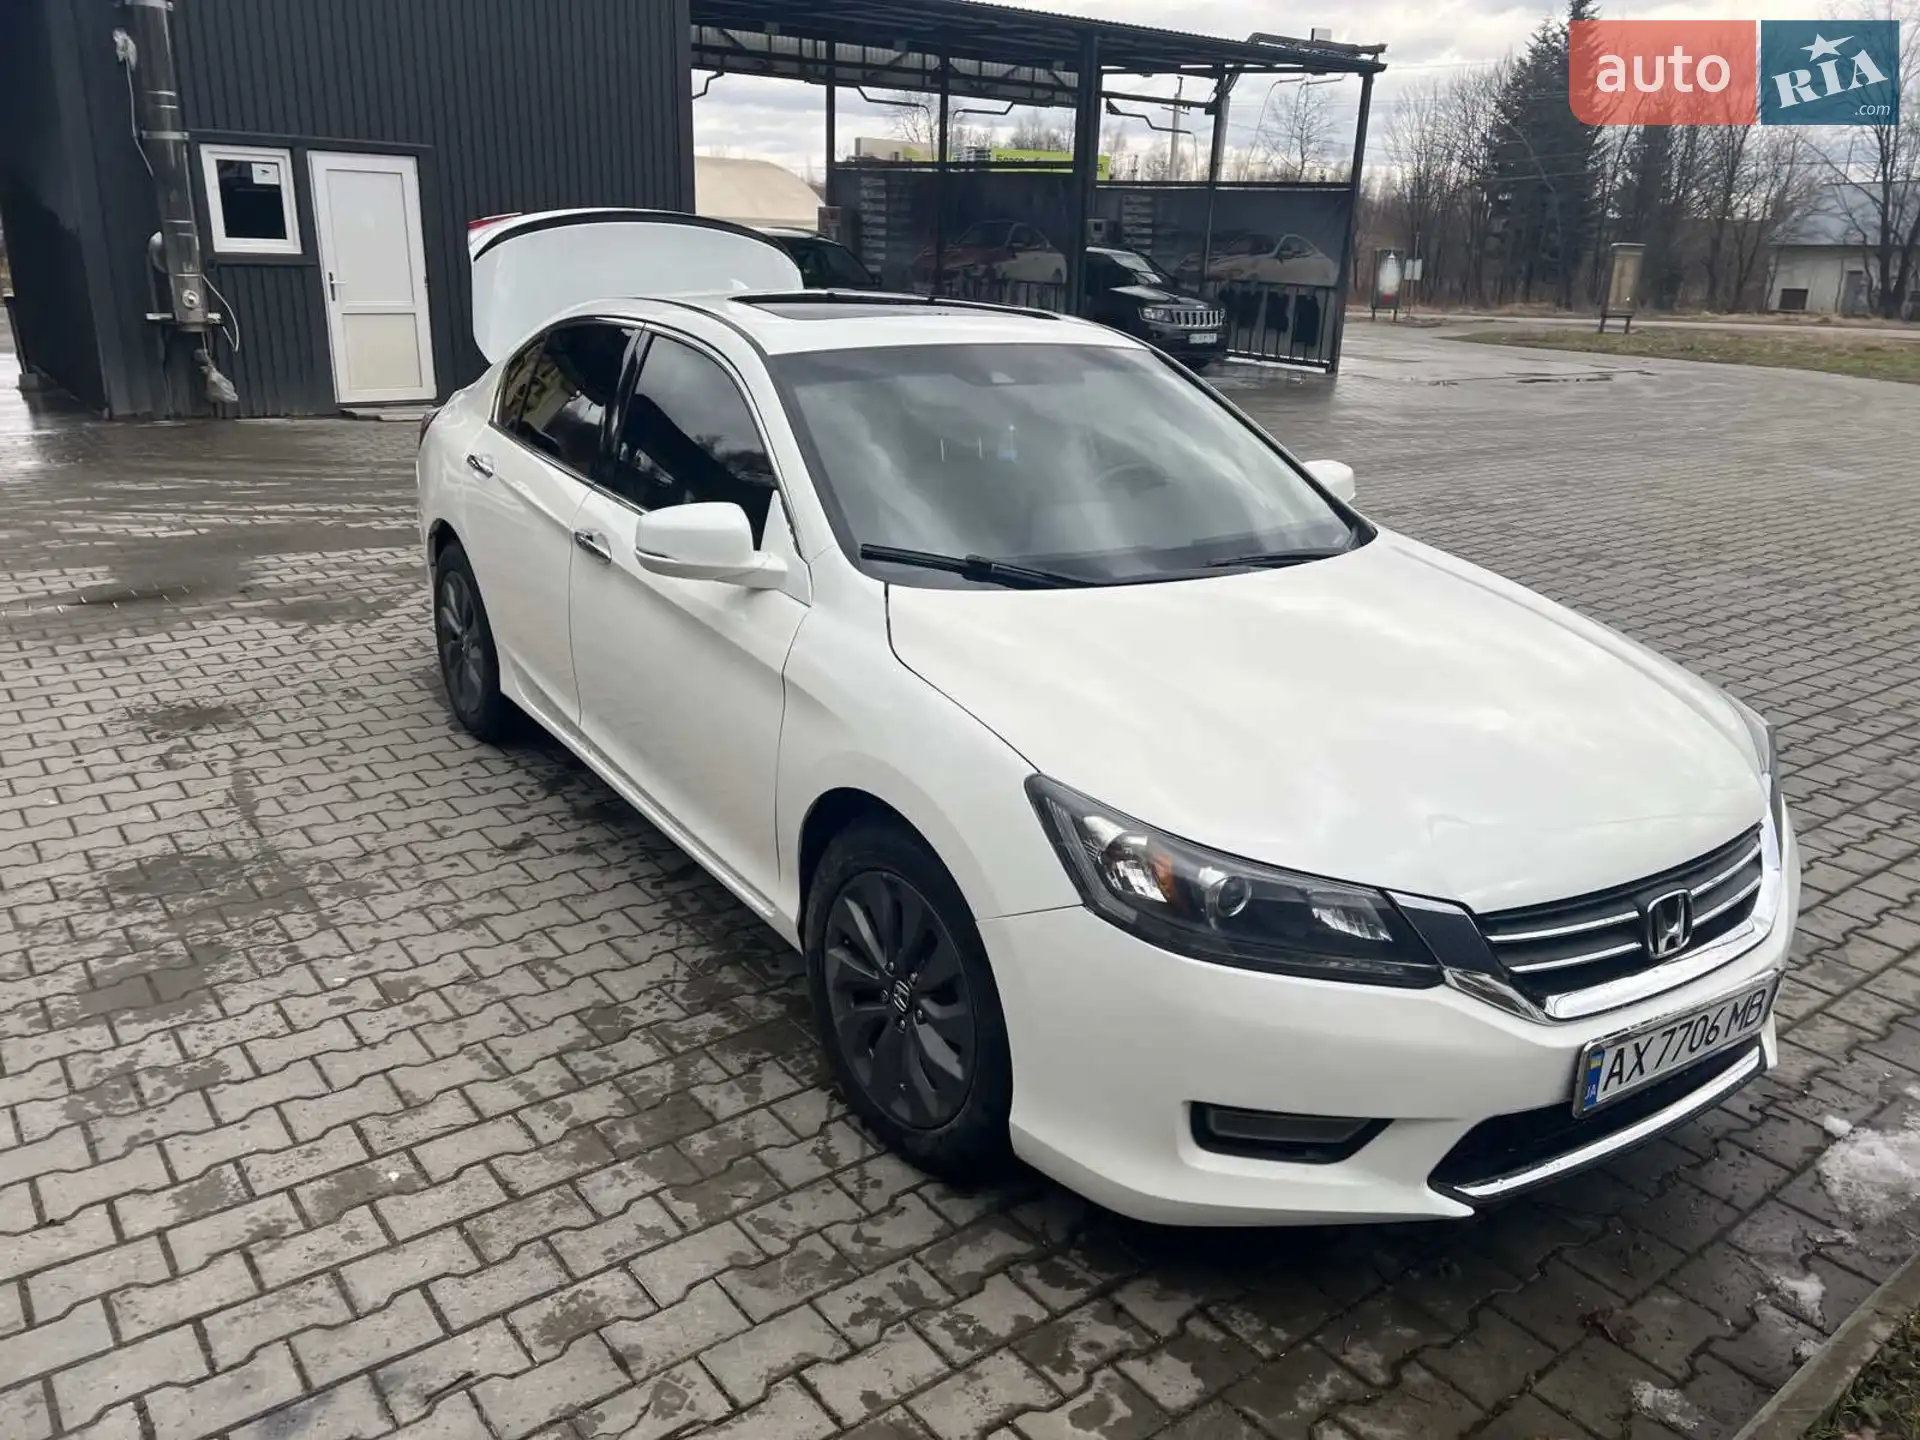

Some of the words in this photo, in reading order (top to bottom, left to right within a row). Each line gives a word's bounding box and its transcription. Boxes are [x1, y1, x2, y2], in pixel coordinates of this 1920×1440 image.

[1602, 1036, 1654, 1092] AX
[1654, 1006, 1726, 1070] 7706
[1723, 988, 1767, 1039] MB
